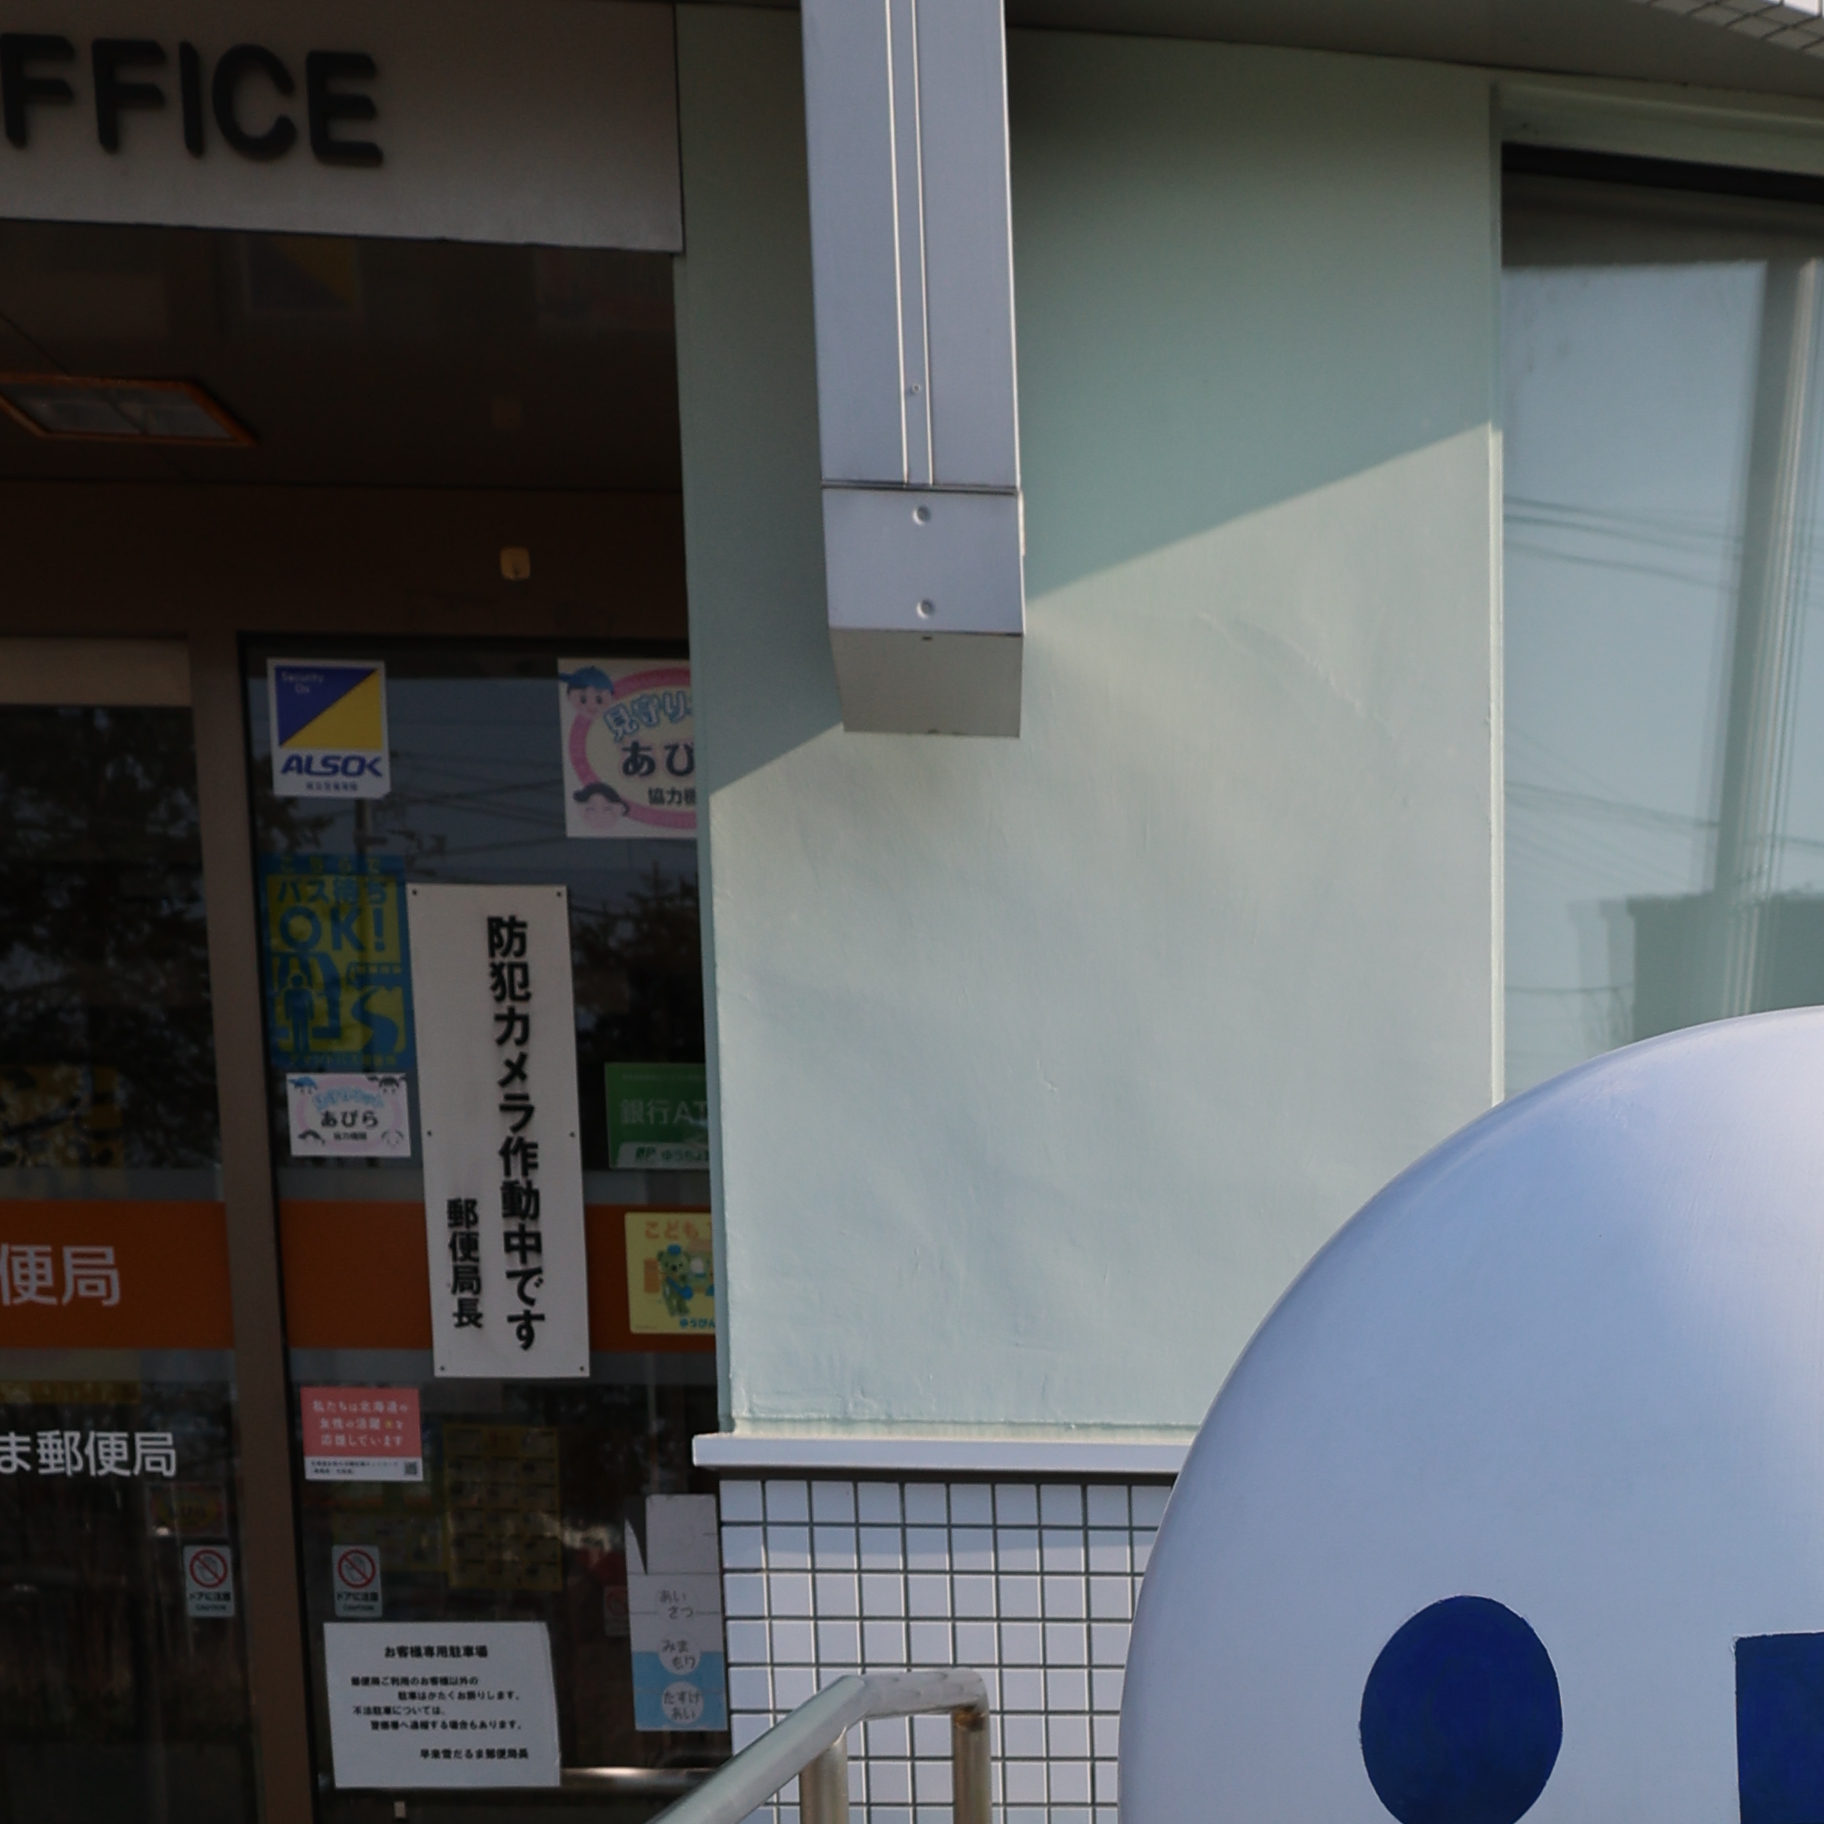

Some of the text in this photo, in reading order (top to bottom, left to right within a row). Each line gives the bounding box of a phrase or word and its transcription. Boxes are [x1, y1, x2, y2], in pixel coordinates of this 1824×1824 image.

[0, 33, 383, 168] FFICE
[281, 753, 383, 777] ALSOK
[279, 905, 385, 952] OK!
[486, 915, 545, 1350] 防犯カメラ作動中です
[0, 1243, 122, 1307] 便局
[447, 1198, 483, 1329] 郵便局長
[0, 1429, 177, 1479] ま郵便局
[385, 1645, 488, 1658] お客様専用駐車場
